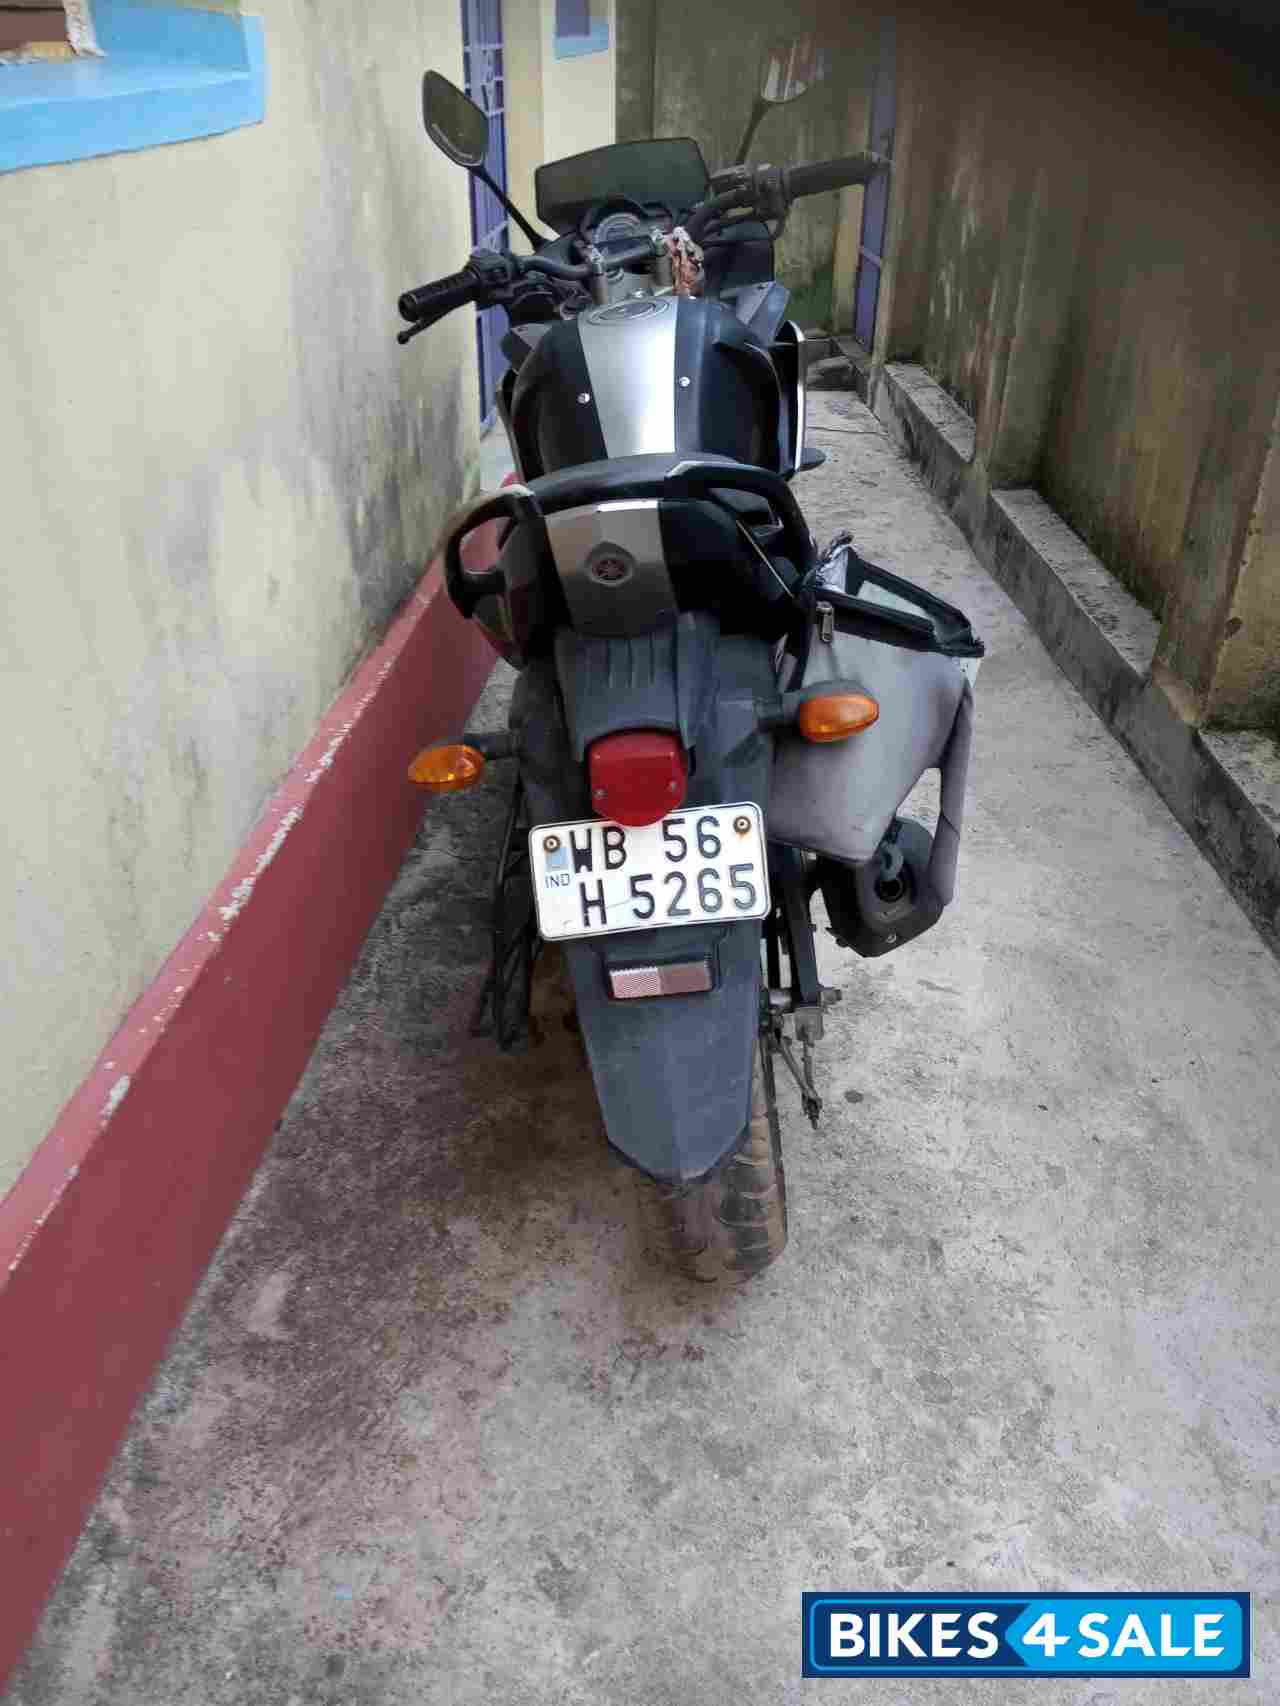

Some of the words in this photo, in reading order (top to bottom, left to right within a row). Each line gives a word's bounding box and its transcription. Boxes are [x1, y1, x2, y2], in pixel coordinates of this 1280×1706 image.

[569, 826, 627, 873] WB
[662, 815, 721, 863] 56
[545, 873, 570, 888] IND
[578, 879, 607, 927] H
[630, 863, 757, 919] 5265
